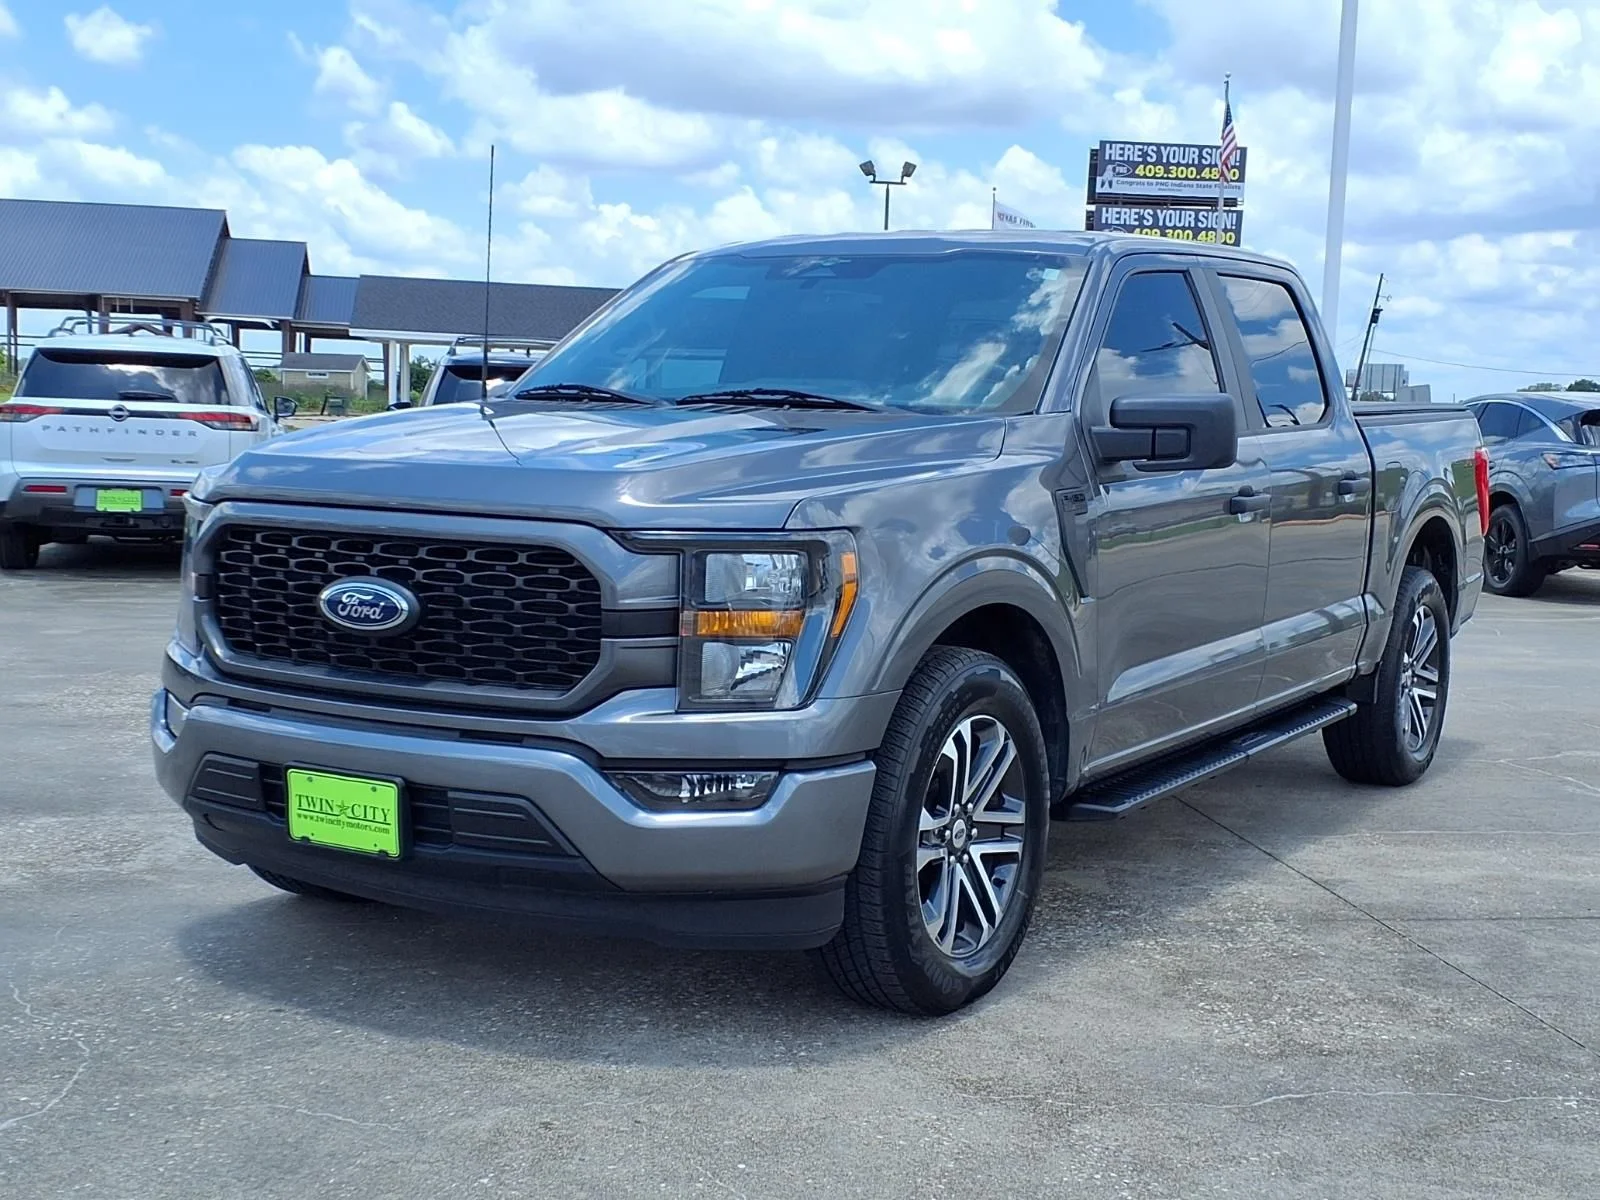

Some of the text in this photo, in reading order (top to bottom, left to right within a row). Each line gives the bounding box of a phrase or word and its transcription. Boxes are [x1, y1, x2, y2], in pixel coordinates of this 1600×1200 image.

[1105, 143, 1157, 163] HERE'S
[1161, 146, 1199, 165] YOUR
[1135, 164, 1240, 180] 409.300.480
[1101, 207, 1154, 225] HERE'S
[1156, 210, 1195, 228] YOUR
[1133, 228, 1236, 244] 409300.4800
[42, 425, 198, 437] PATHFINDER
[337, 592, 385, 619] Ford
[296, 793, 390, 822] TWIN CITY
[297, 813, 390, 834] www.twincitymotors.com
